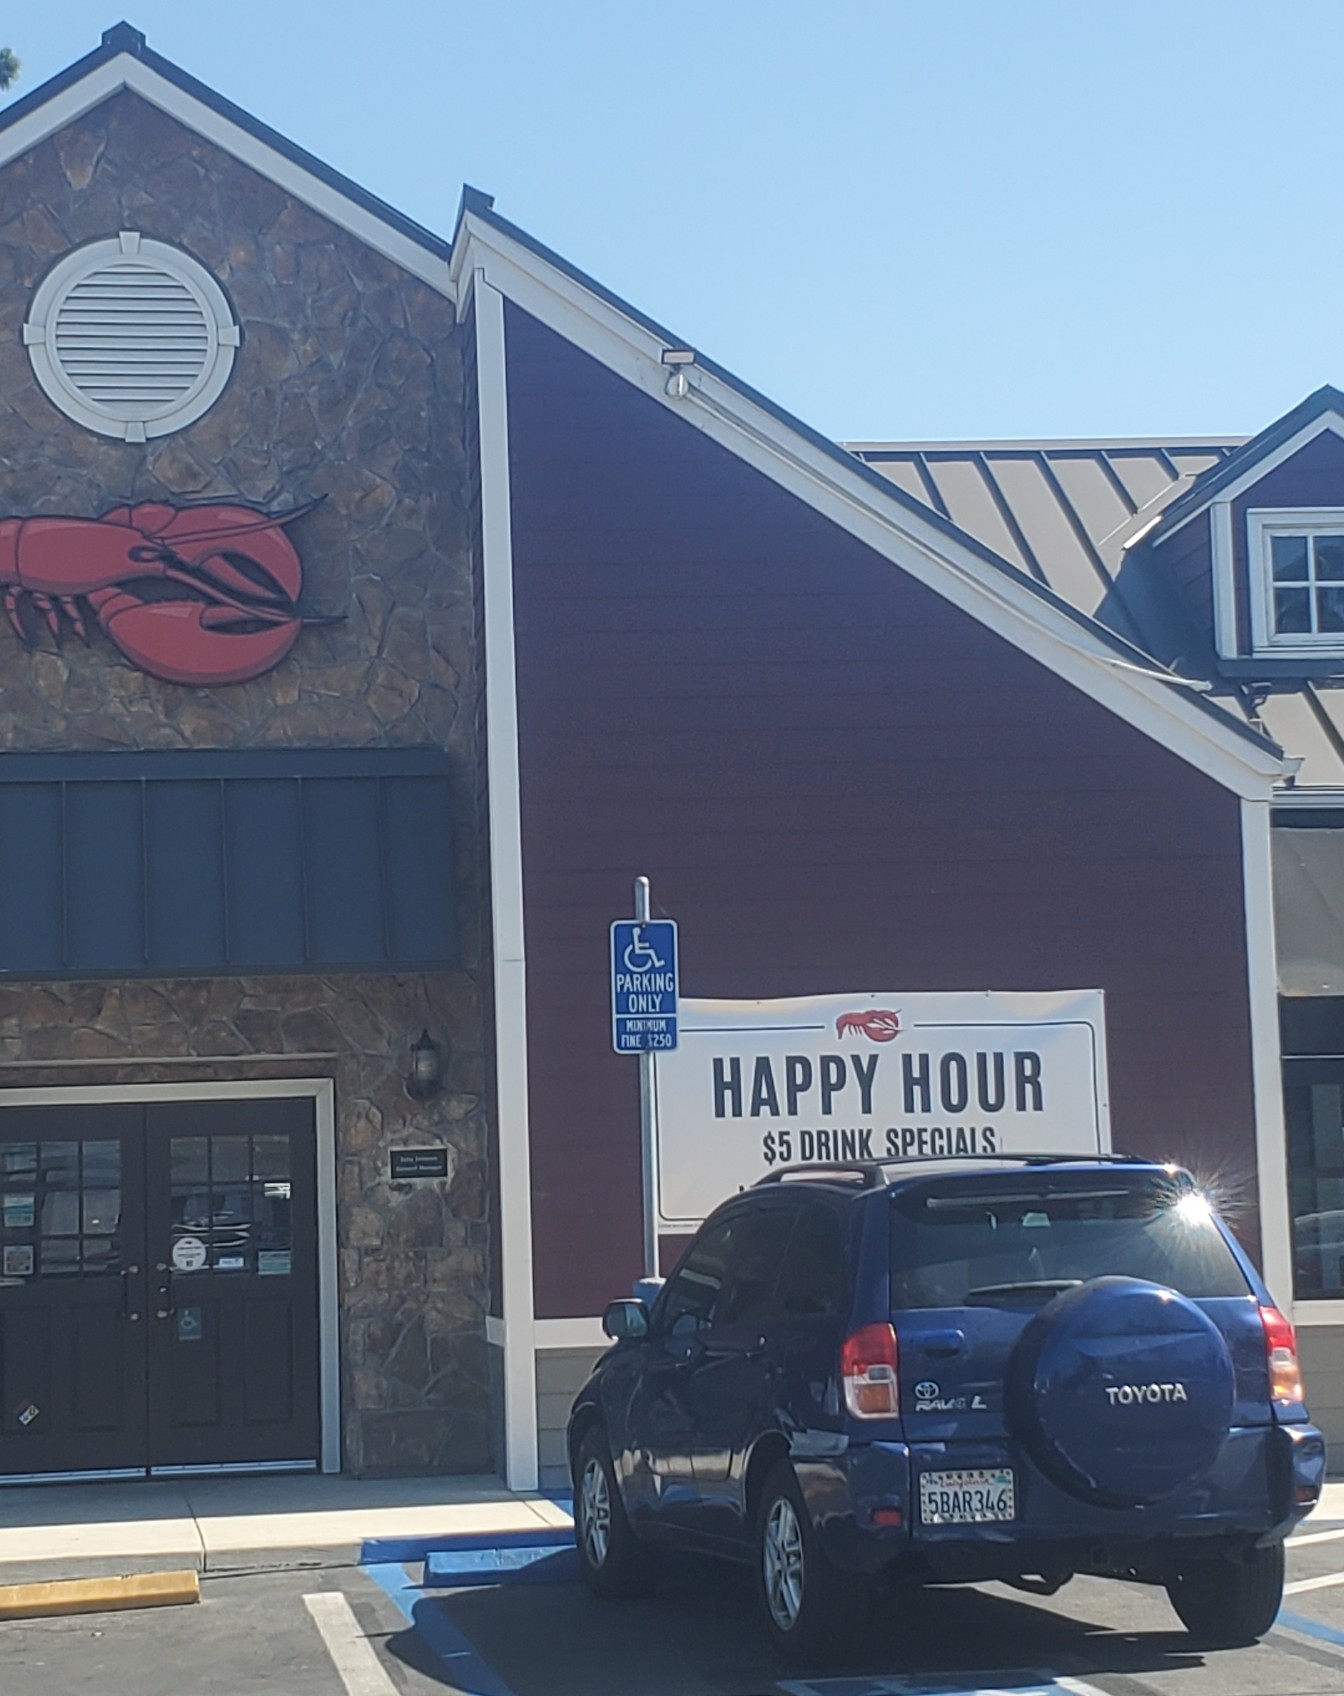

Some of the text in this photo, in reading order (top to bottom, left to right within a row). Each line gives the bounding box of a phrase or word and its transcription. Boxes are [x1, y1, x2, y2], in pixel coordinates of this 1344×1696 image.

[616, 972, 674, 993] PARKING
[628, 993, 663, 1013] ONLY
[626, 1019, 667, 1032] MINIMUM
[621, 1033, 672, 1048] FINE $250
[712, 1051, 1044, 1118] HAPPY HOUR
[763, 1126, 996, 1166] $5 DRINK SPECIALS
[1106, 1383, 1187, 1406] TOYOTA
[927, 1489, 1007, 1514] 5BAR346
